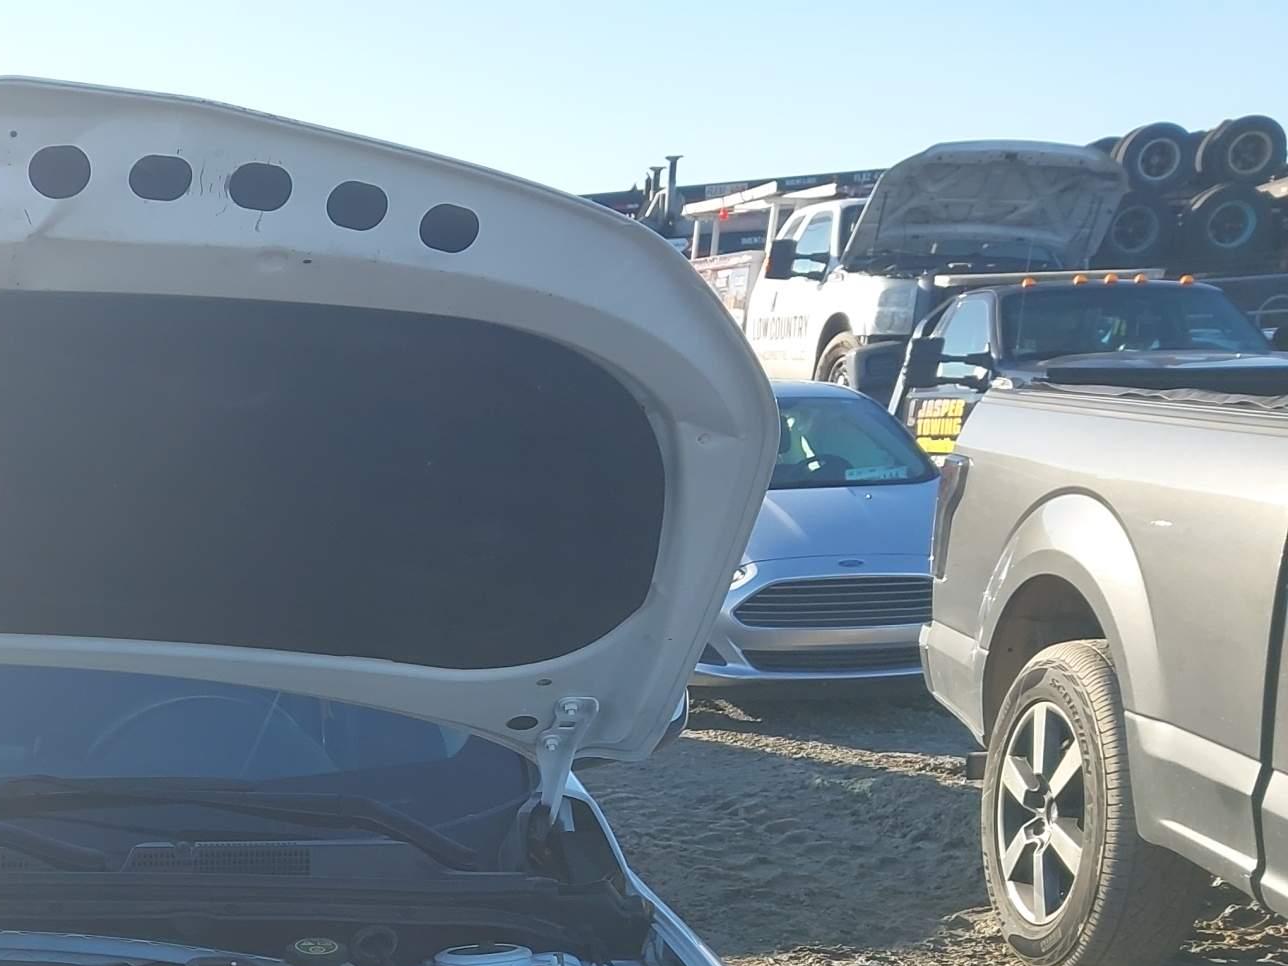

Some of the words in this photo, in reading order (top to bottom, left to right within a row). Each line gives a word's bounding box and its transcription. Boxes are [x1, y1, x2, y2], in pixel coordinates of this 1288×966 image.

[752, 317, 769, 341] LOW
[770, 315, 810, 341] COUNTRY
[917, 398, 966, 418] JASPER
[916, 417, 962, 436] TOWING
[1048, 677, 1093, 776] SCORPION
